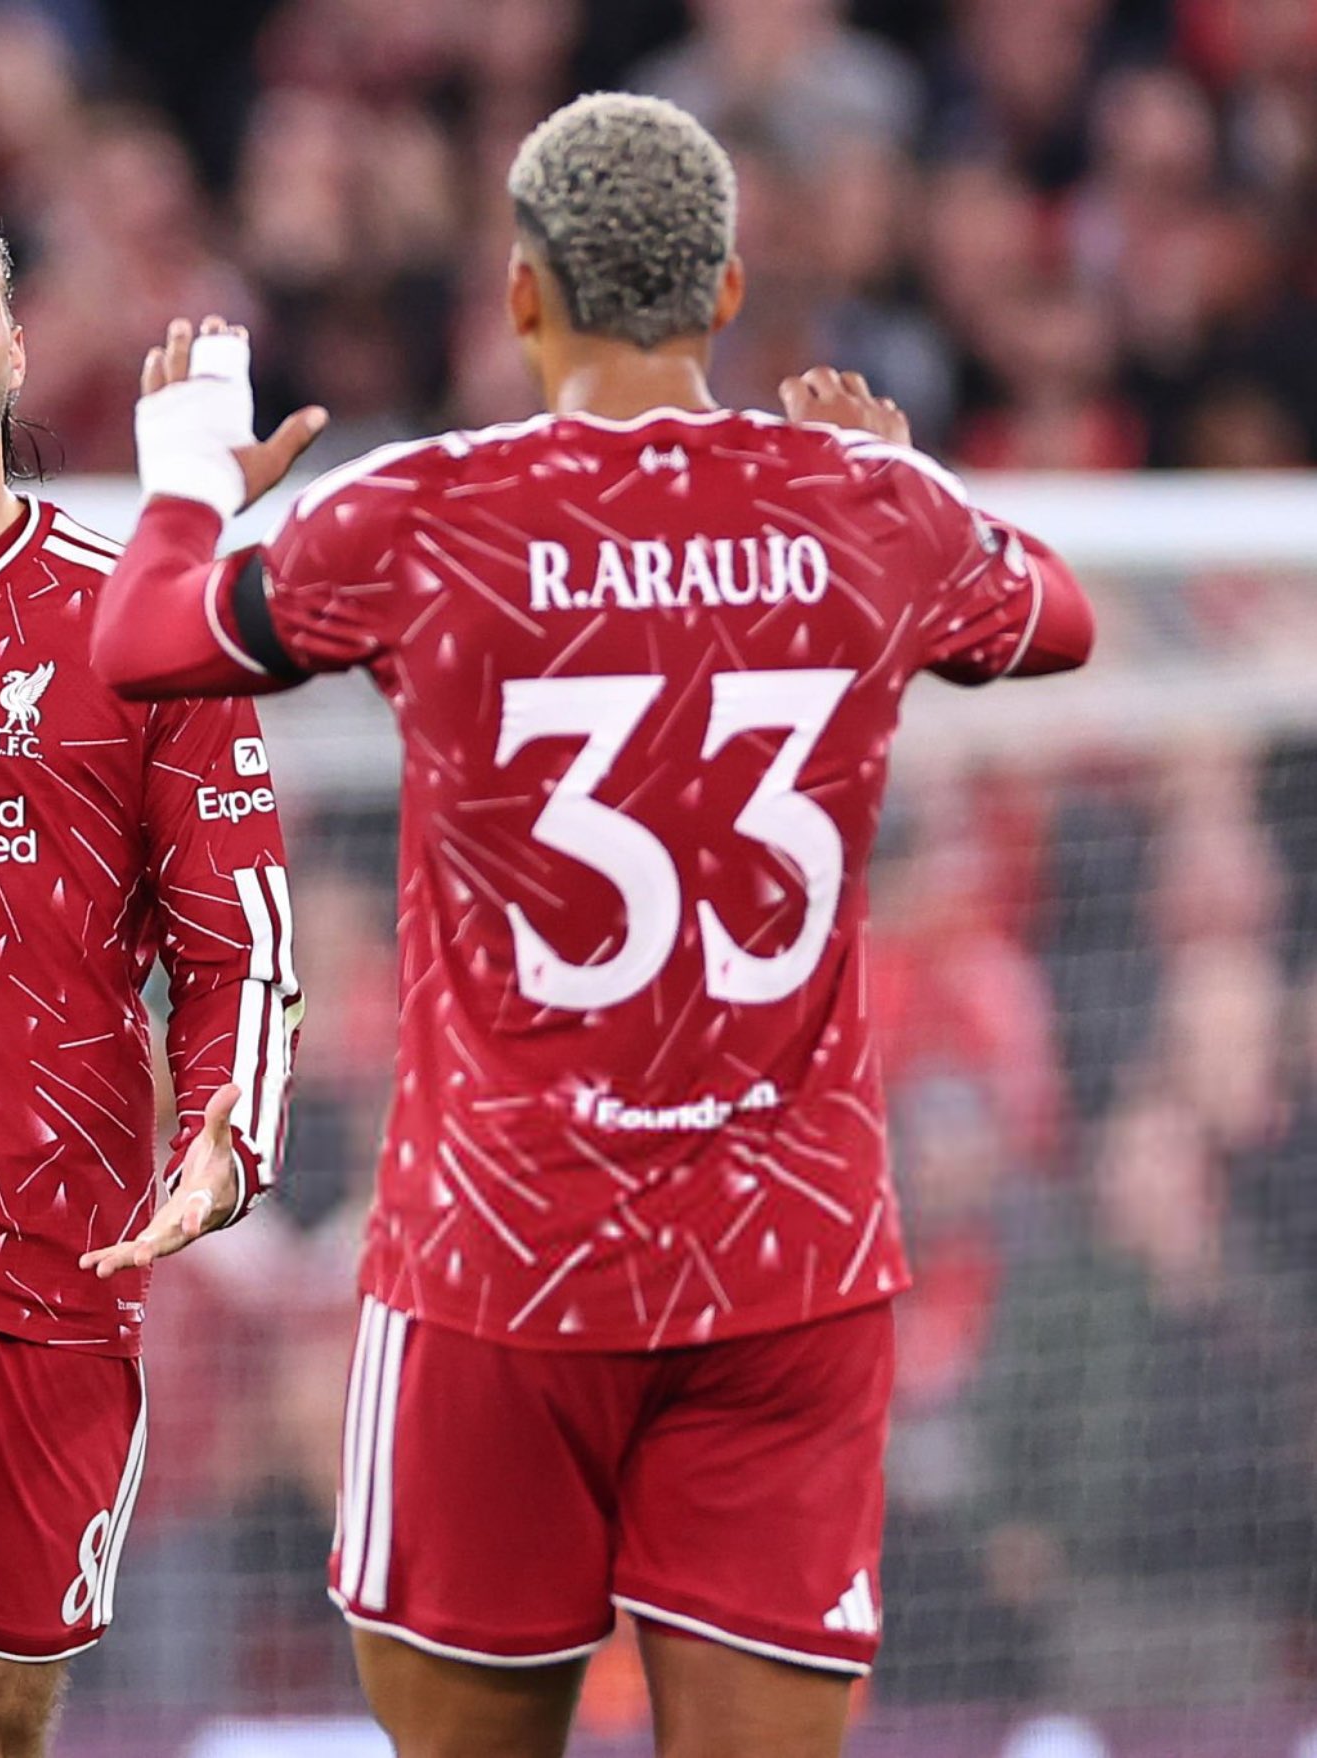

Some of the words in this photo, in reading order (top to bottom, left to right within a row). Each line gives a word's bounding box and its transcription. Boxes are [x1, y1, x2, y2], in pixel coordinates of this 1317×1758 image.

[528, 534, 829, 612] R.ARAUJO
[196, 786, 276, 824] Expe
[494, 669, 858, 1012] 33
[61, 1508, 111, 1626] 8
